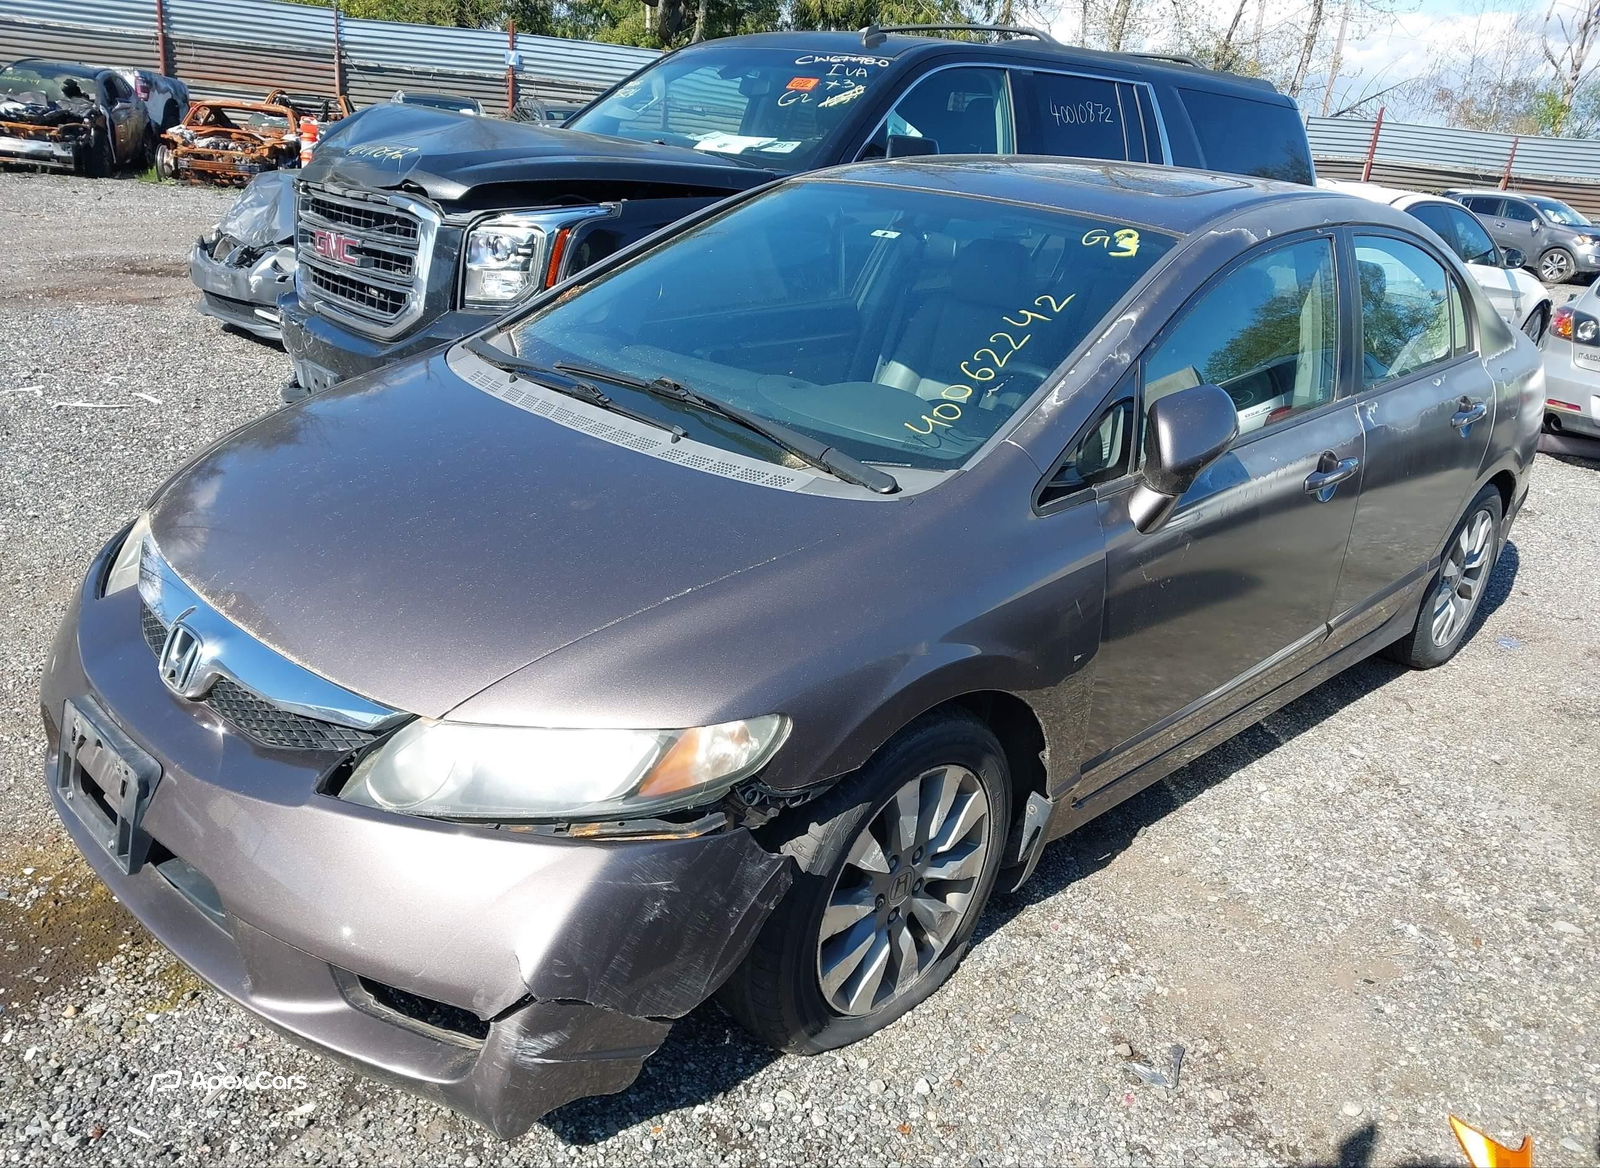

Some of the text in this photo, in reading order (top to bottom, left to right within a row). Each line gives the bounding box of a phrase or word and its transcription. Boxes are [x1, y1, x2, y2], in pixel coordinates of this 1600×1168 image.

[1049, 96, 1114, 126] 40010872
[314, 229, 363, 265] GMC
[904, 293, 1076, 434] 40062242
